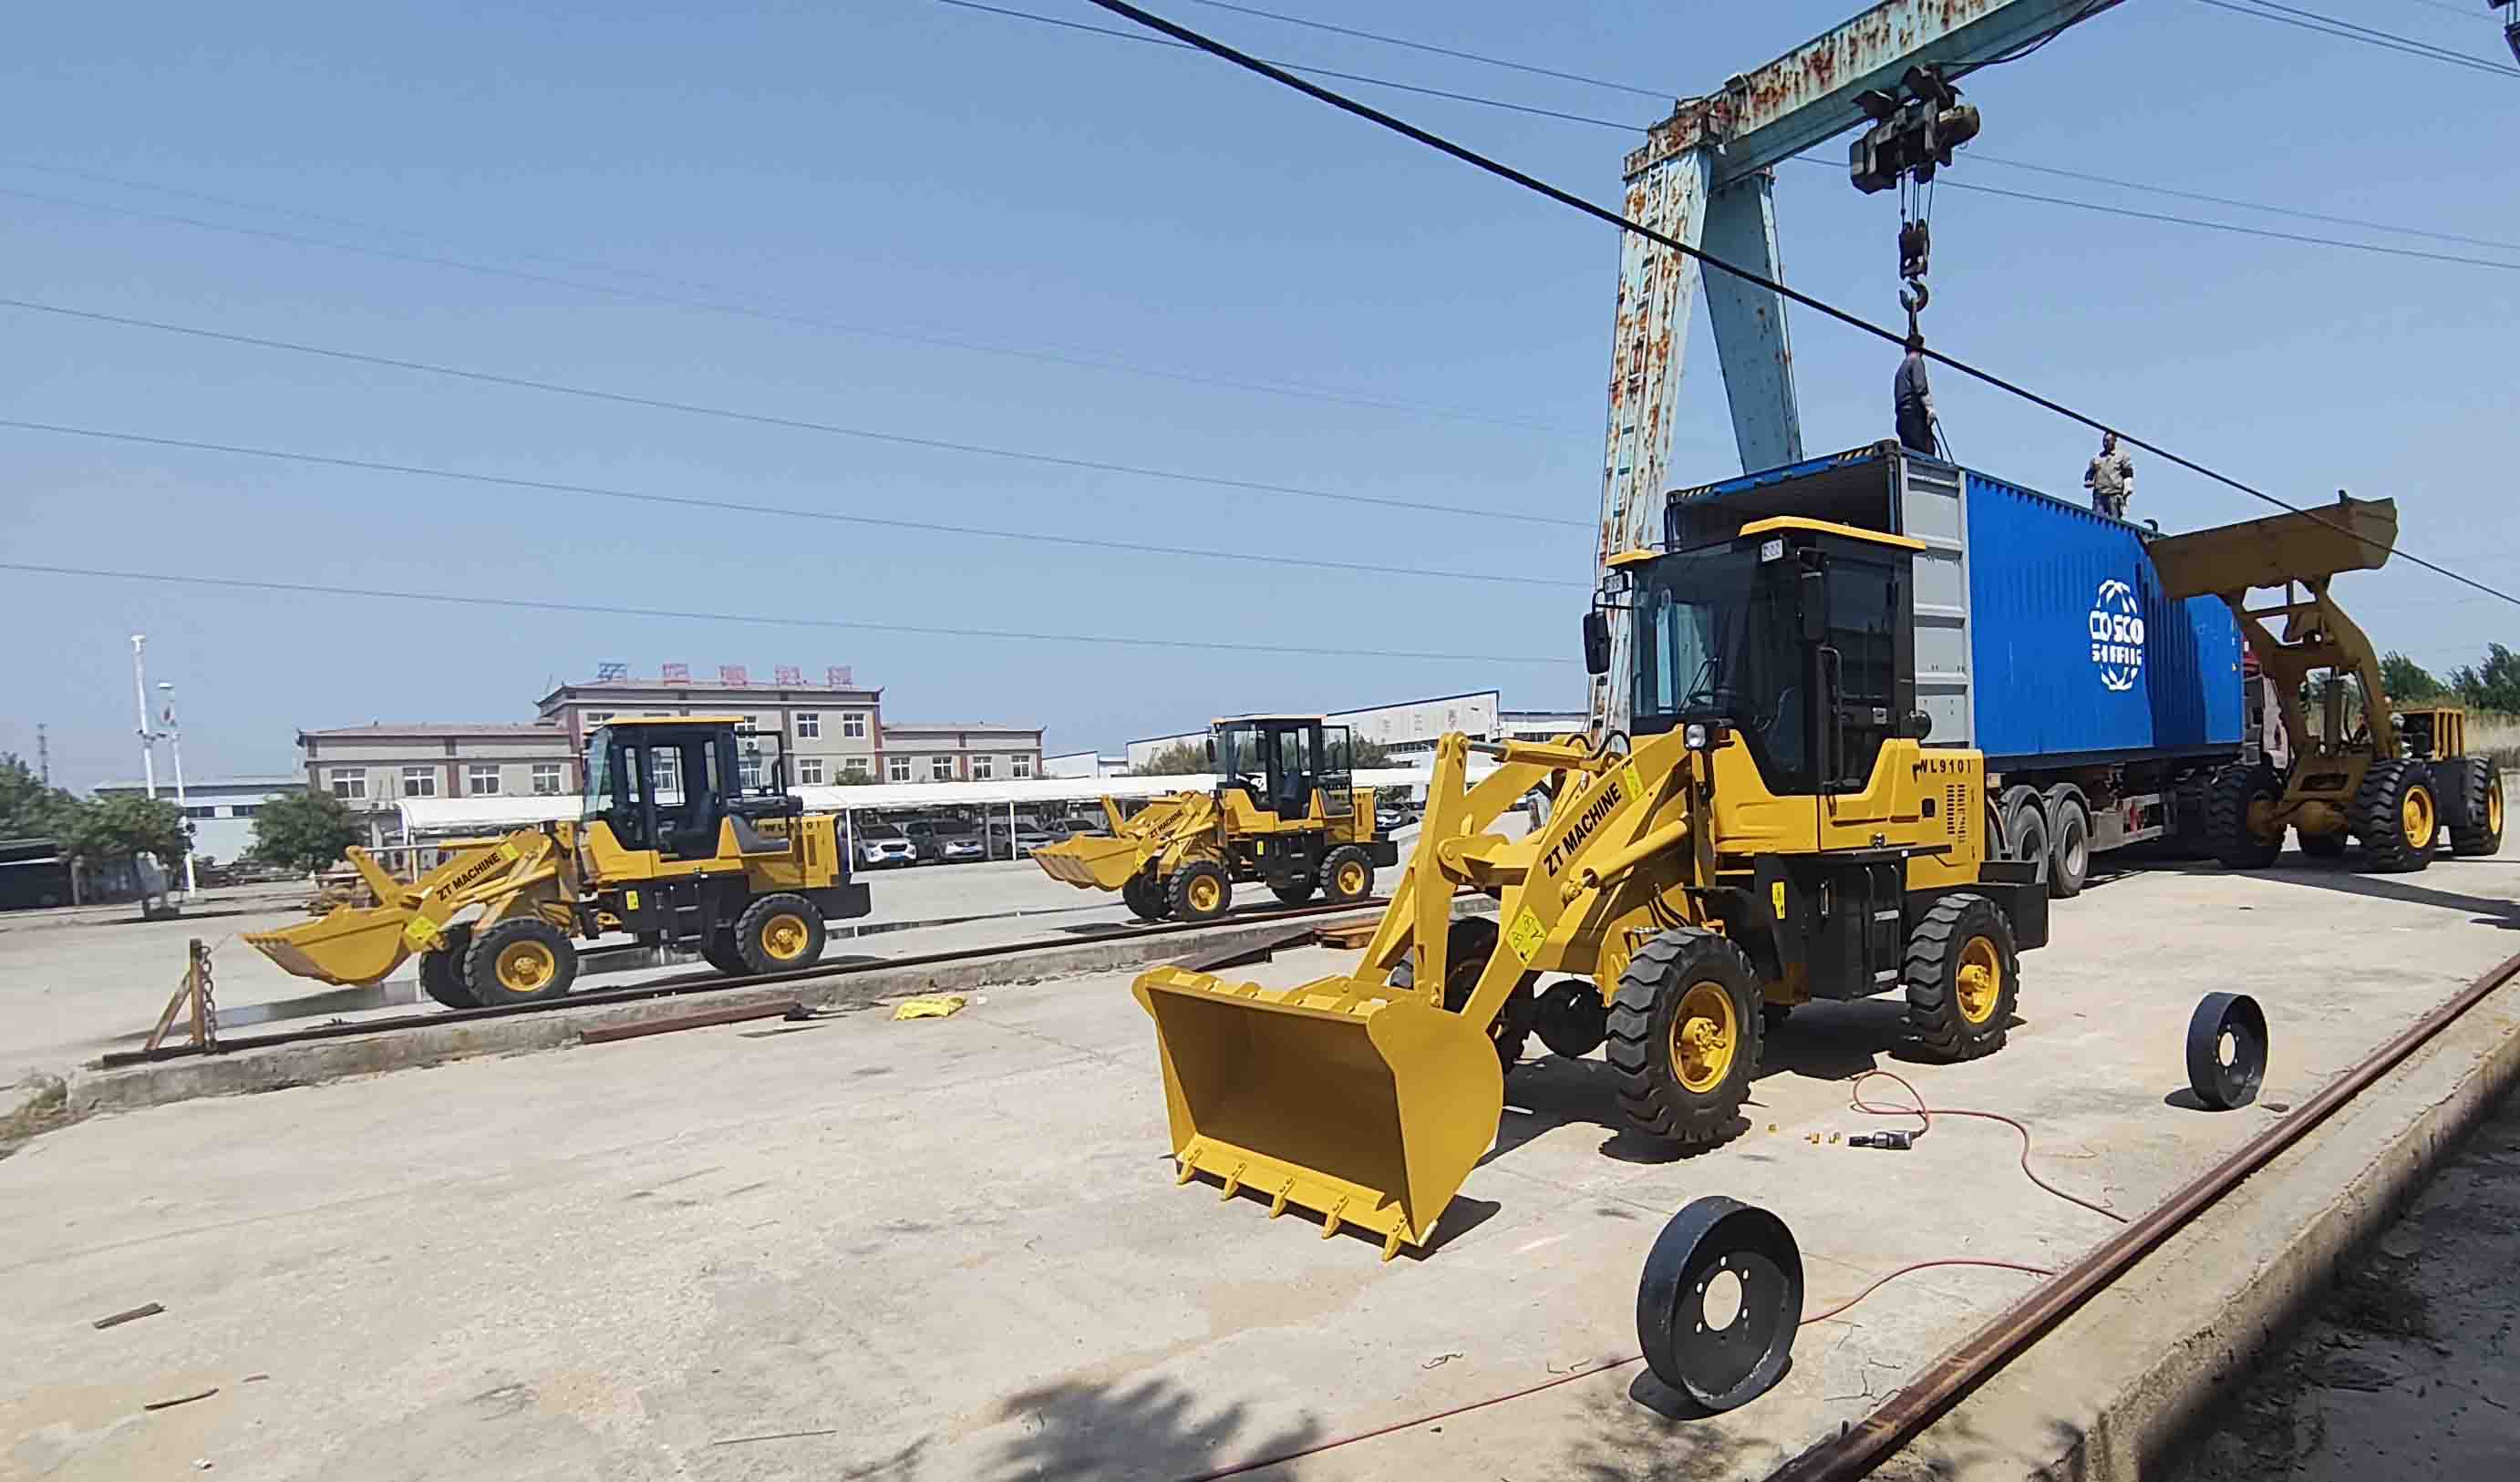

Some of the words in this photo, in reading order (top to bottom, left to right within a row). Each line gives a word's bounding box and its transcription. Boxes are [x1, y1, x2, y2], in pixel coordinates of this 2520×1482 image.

[2090, 611, 2144, 645] COSCO
[1158, 808, 1184, 832] MACHINE
[1544, 846, 1567, 878] ZT
[1563, 781, 1623, 857] MACHINE
[436, 885, 453, 902] ZT
[452, 852, 501, 890] MACHINE
